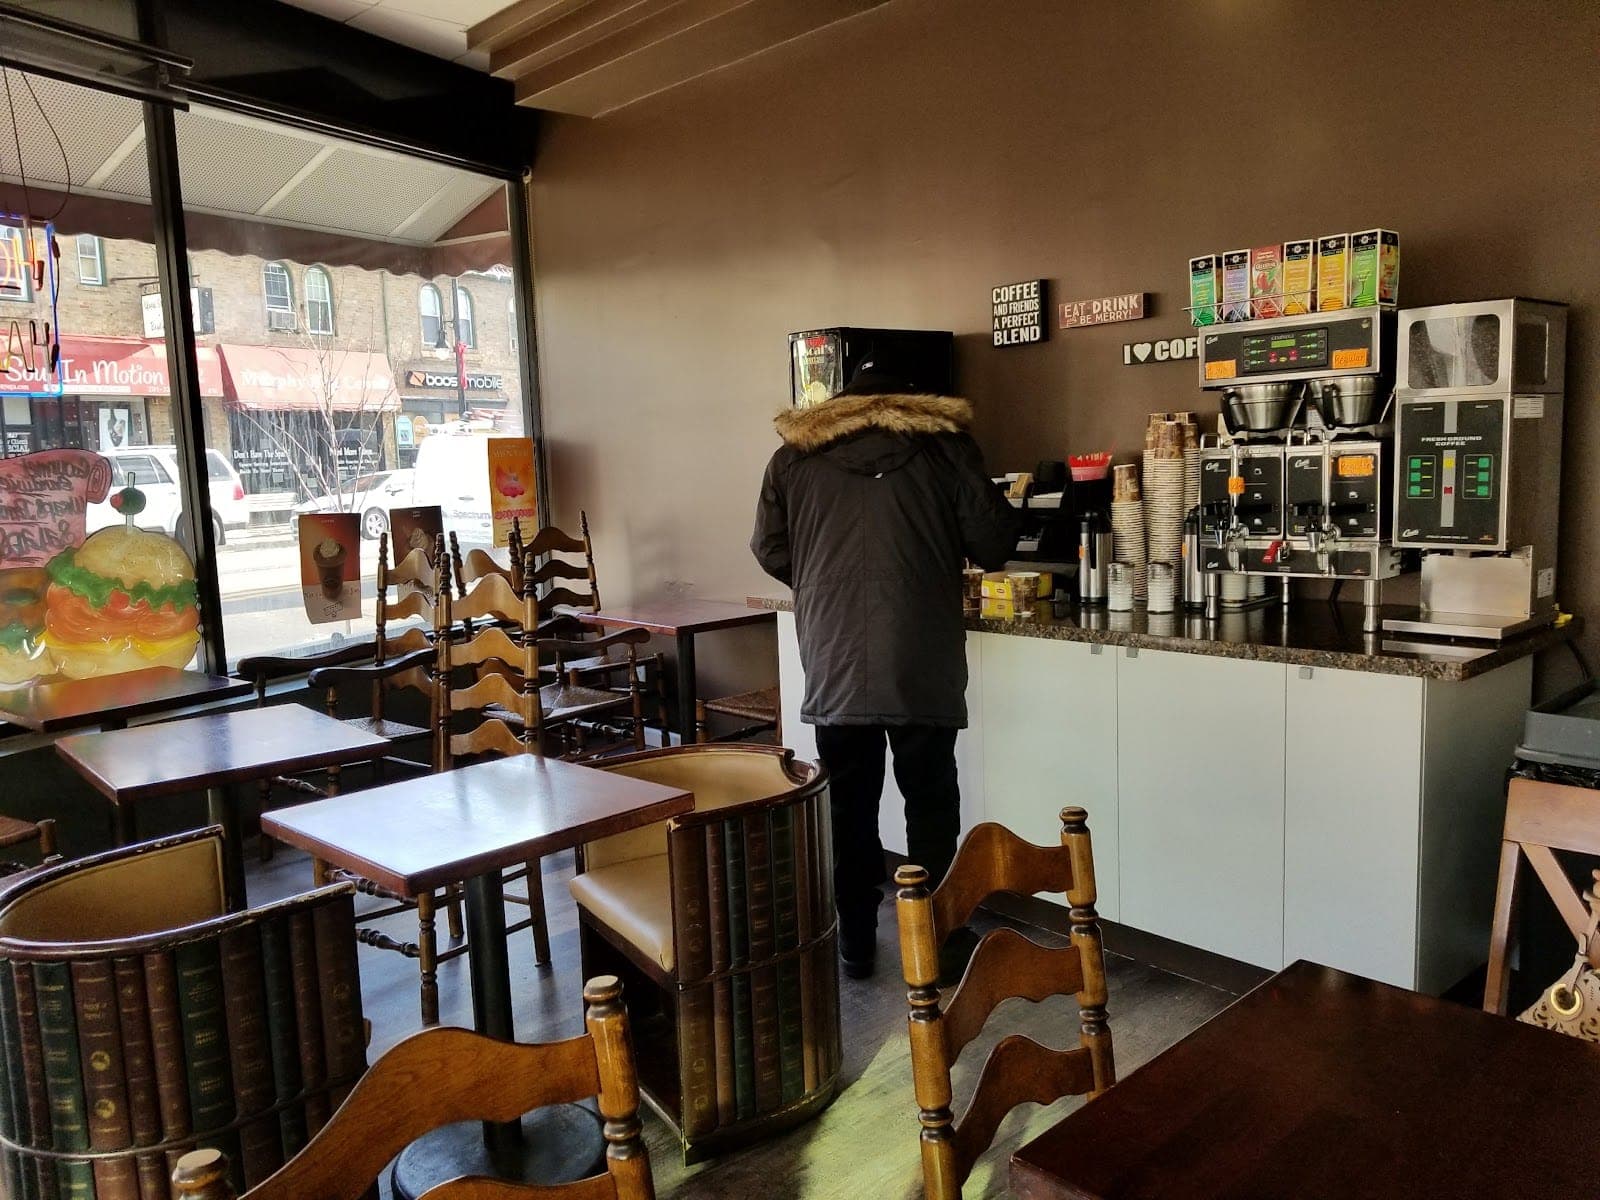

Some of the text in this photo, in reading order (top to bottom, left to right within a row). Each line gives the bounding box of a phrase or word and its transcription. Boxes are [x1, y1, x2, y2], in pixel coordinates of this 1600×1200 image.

[992, 281, 1038, 304] COFFEE
[993, 299, 1039, 316] AND FRIENDS
[1064, 294, 1139, 318] EAT DRINK
[993, 312, 1039, 329] A PERFECT
[1080, 315, 1092, 325] BE
[1095, 309, 1132, 323] MERRY!
[993, 326, 1041, 346] BLEND
[1123, 337, 1199, 365] I COF
[62, 359, 88, 384] In
[93, 360, 164, 385] Motion
[425, 373, 503, 388] boos mobile
